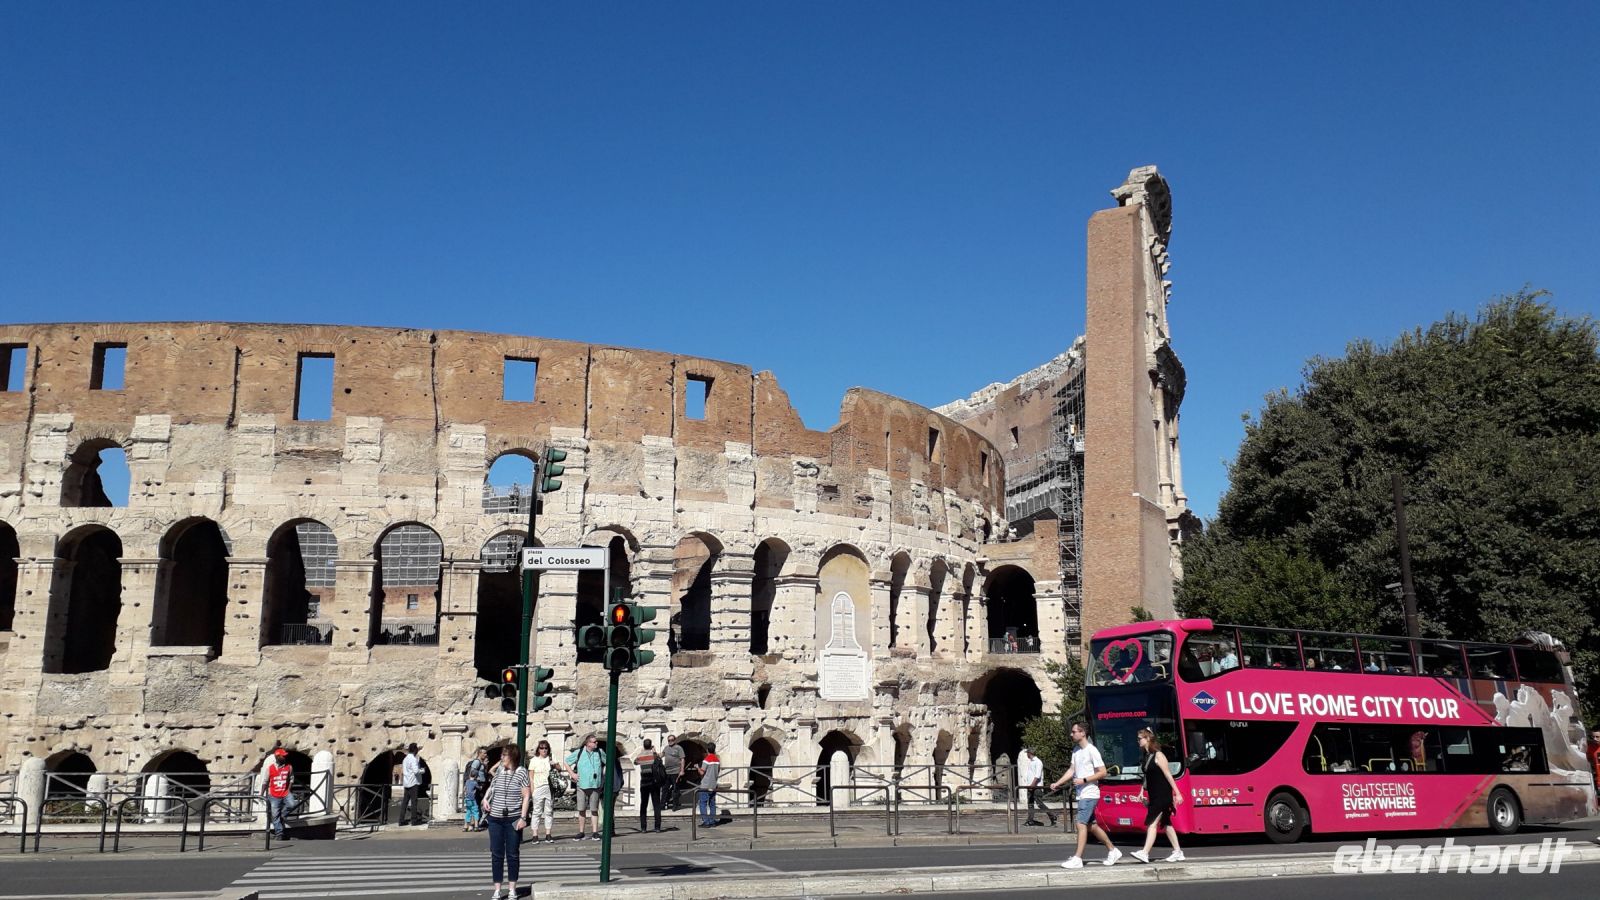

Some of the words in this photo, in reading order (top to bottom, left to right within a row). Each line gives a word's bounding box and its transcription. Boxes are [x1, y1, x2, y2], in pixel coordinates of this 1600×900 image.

[527, 556, 543, 565] del
[547, 556, 591, 565] Colosseo
[1226, 691, 1234, 714] I
[1238, 691, 1295, 715] LOVE
[1298, 693, 1358, 717] ROME
[1361, 696, 1404, 718] CITY
[1407, 697, 1460, 719] TOUR
[1341, 782, 1415, 797] SIGHTSEEING
[1343, 796, 1417, 811] EVERYWHERE
